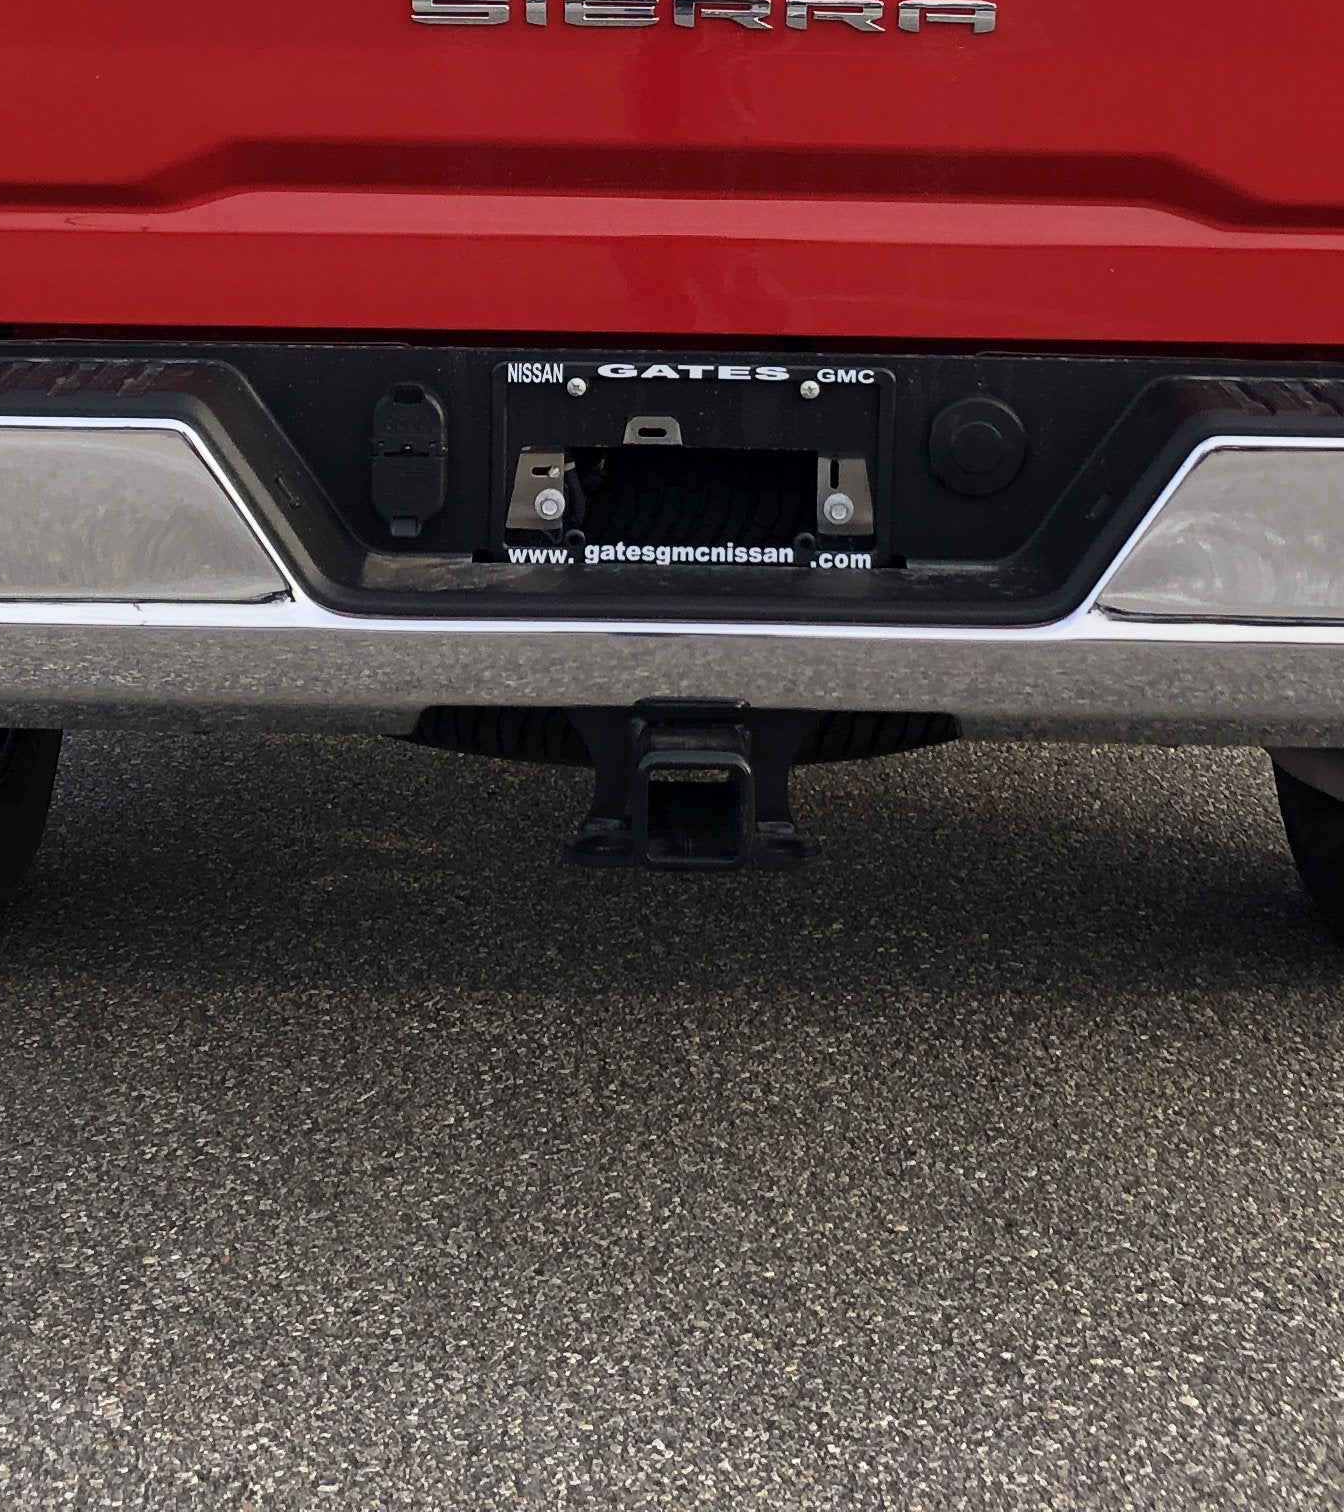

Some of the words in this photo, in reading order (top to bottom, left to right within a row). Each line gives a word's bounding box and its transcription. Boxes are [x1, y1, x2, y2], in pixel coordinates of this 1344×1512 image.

[507, 362, 563, 384] NISSAN
[597, 363, 790, 381] GATES
[816, 368, 875, 384] GMC
[508, 548, 574, 564] www.
[584, 541, 794, 566] gatesgmcnissan
[810, 552, 872, 569] .com
